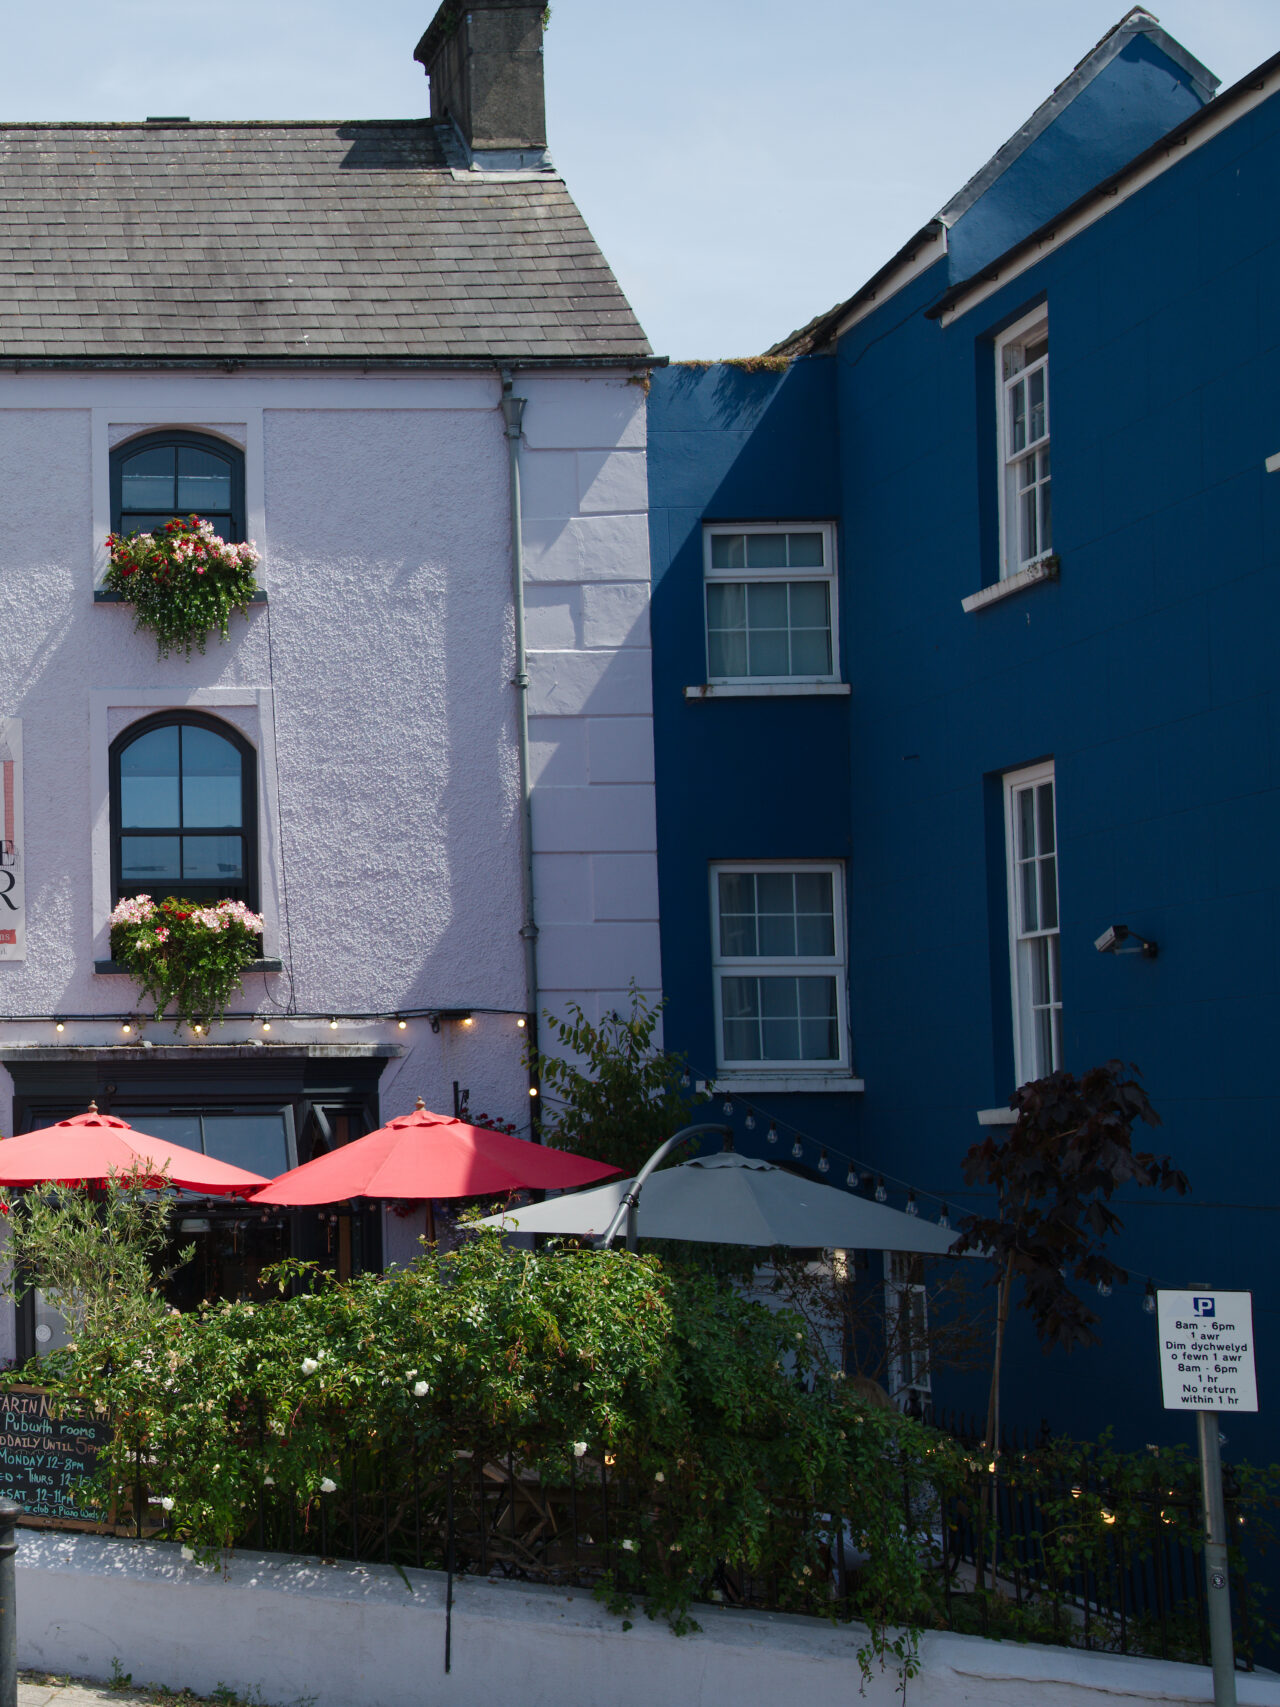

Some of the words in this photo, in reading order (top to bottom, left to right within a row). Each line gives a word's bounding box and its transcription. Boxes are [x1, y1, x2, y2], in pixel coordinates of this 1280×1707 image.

[1175, 1320, 1199, 1330] 8am
[1211, 1321, 1235, 1332] 6pm
[1200, 1333, 1220, 1341] awr
[1165, 1341, 1186, 1350] Dim
[1191, 1342, 1248, 1353] dychwelyd
[1182, 1351, 1209, 1361] fewn
[1213, 1353, 1218, 1361] 1
[1222, 1354, 1242, 1362] awr
[1177, 1363, 1201, 1372] 8am
[1214, 1364, 1238, 1374] 6pm
[1198, 1374, 1202, 1383] 1
[1207, 1374, 1218, 1383] hr
[1182, 1384, 1198, 1393] No
[1202, 1385, 1236, 1394] return
[1181, 1395, 1214, 1404] within
[1218, 1396, 1223, 1404] 1
[1228, 1396, 1239, 1405] hr
[5, 1411, 29, 1433] Pub
[29, 1418, 53, 1435] with
[7, 1433, 40, 1449] DAILY
[42, 1437, 74, 1452] UNTIL
[24, 1467, 54, 1486] THURS
[6, 1488, 27, 1500] SAT
[32, 1504, 49, 1514] club
